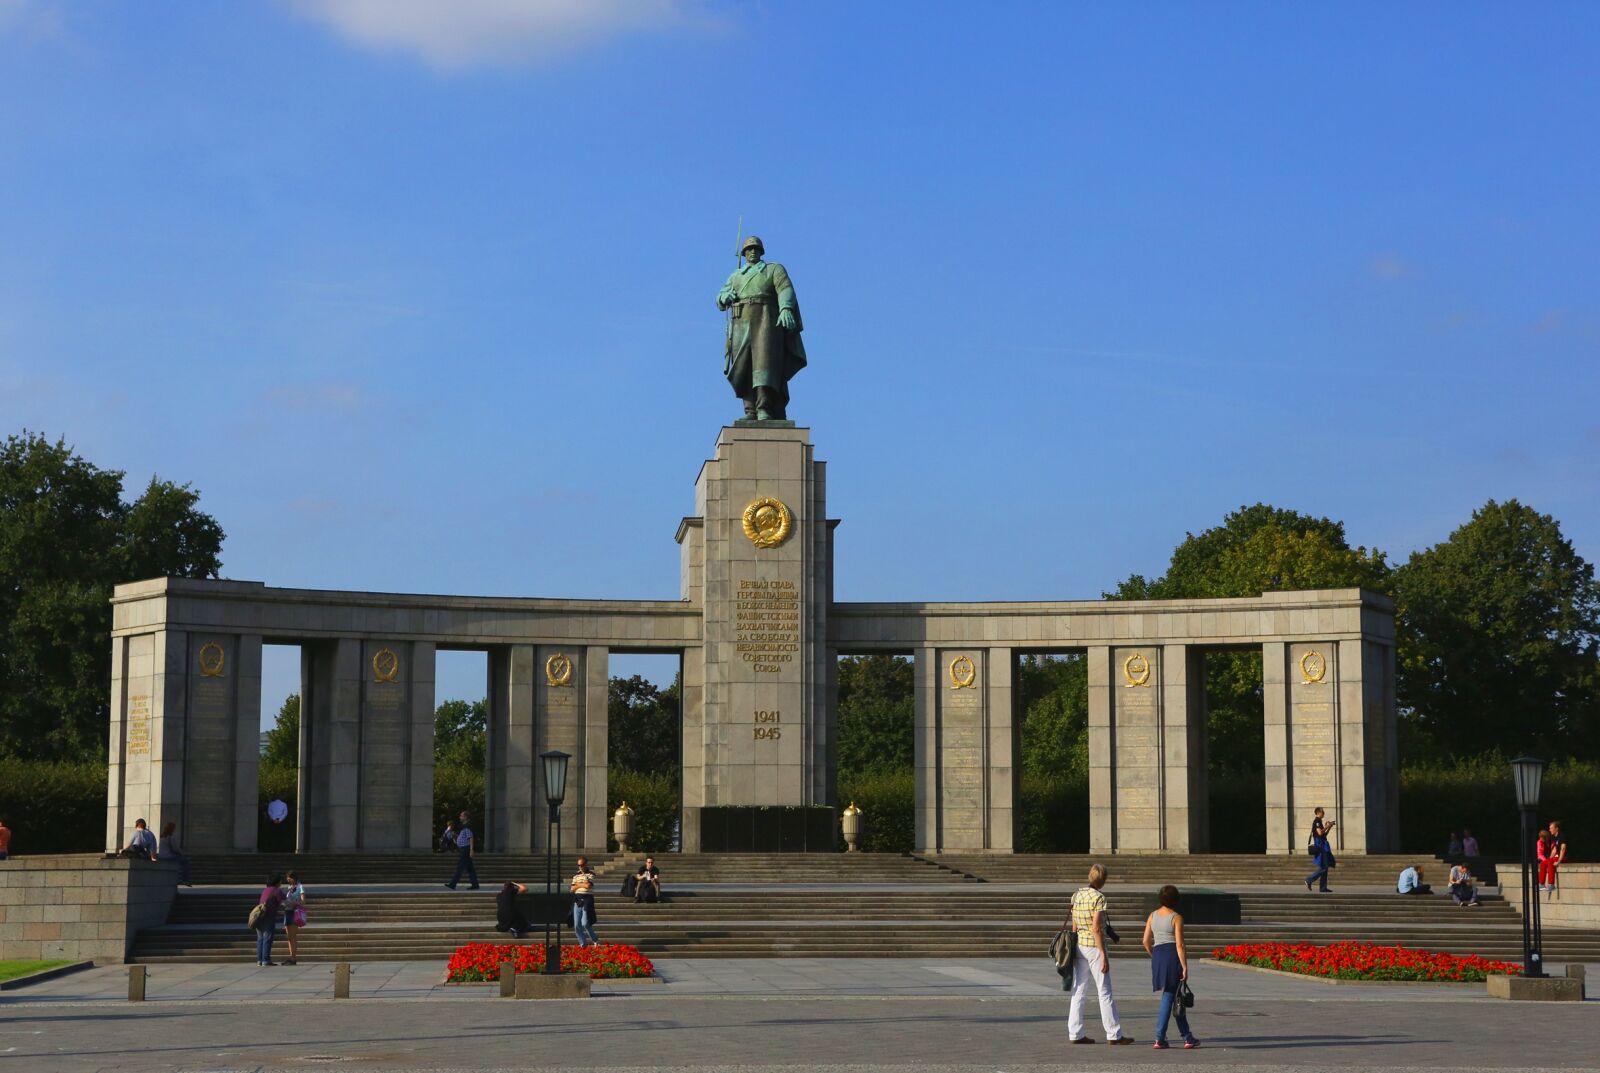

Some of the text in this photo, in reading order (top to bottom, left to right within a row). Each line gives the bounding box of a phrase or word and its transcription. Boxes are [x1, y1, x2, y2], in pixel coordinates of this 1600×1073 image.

[750, 633, 791, 641] СВОБОДУ
[754, 710, 780, 723] 1941
[753, 727, 781, 740] 1945
